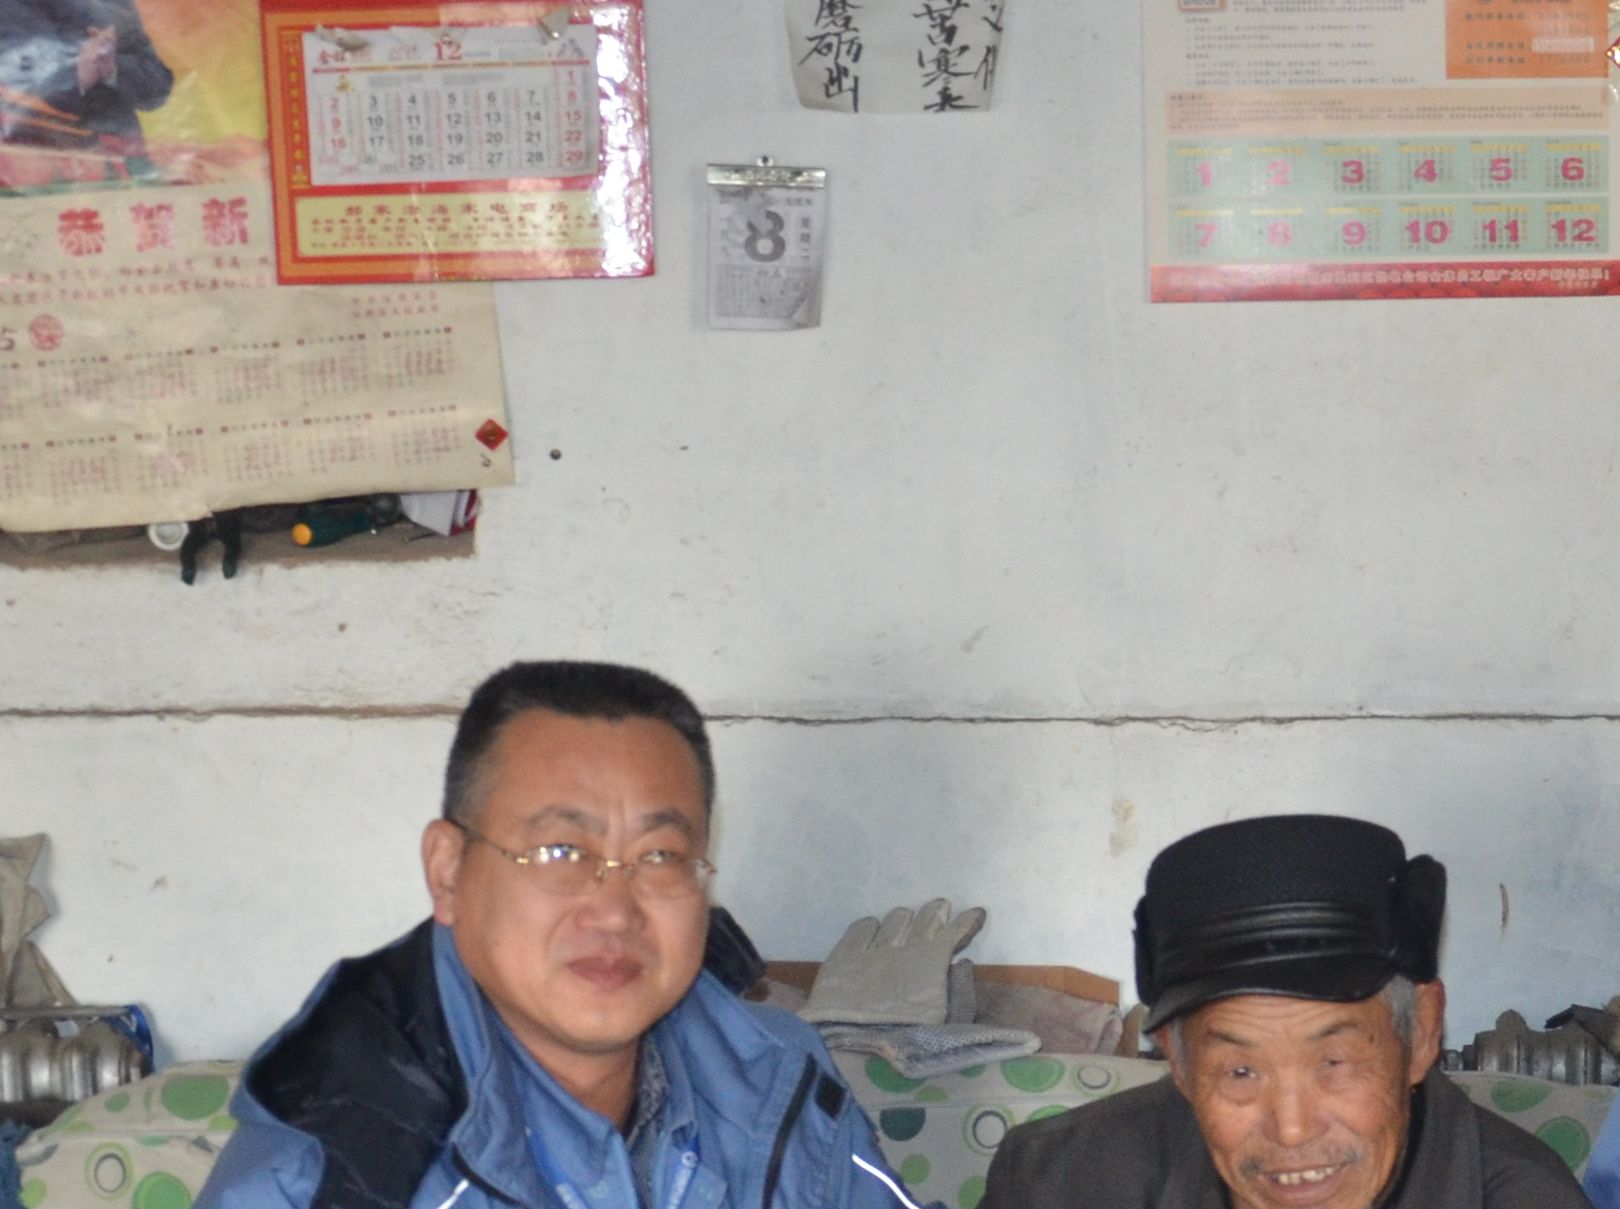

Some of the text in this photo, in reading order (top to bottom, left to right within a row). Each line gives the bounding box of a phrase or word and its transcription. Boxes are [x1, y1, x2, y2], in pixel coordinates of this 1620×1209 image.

[367, 116, 383, 127] 10
[407, 114, 421, 125] 11
[526, 112, 541, 122] 14
[566, 111, 582, 122] 15
[370, 136, 384, 146] 17
[526, 132, 542, 143] 21
[487, 153, 503, 164] 27
[1266, 159, 1293, 187] 2
[1341, 159, 1366, 185] 3
[1413, 158, 1439, 184] 4
[1490, 156, 1514, 182] 5
[1560, 156, 1585, 181] 6
[1194, 218, 1599, 248] 7 8 9 10 11 12
